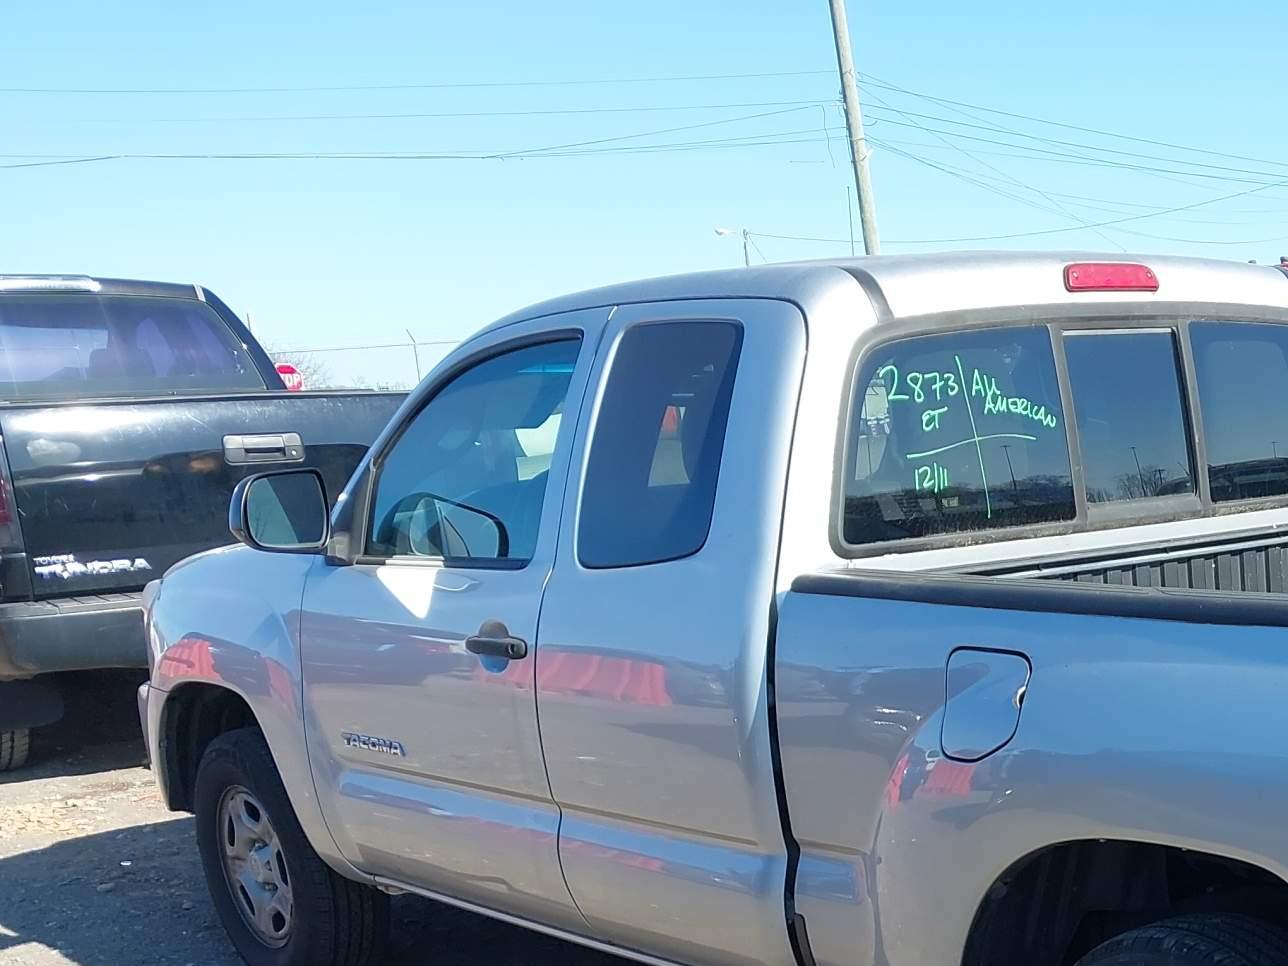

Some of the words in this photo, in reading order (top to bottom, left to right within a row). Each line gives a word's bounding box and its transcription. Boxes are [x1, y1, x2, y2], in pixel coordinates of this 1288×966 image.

[879, 365, 959, 402] 2873
[984, 397, 1057, 428] AMERICAN
[914, 462, 948, 493] 12/11
[33, 554, 74, 565] TOYOTA
[34, 558, 152, 579] TUNDRA
[342, 732, 406, 757] TACOMA
